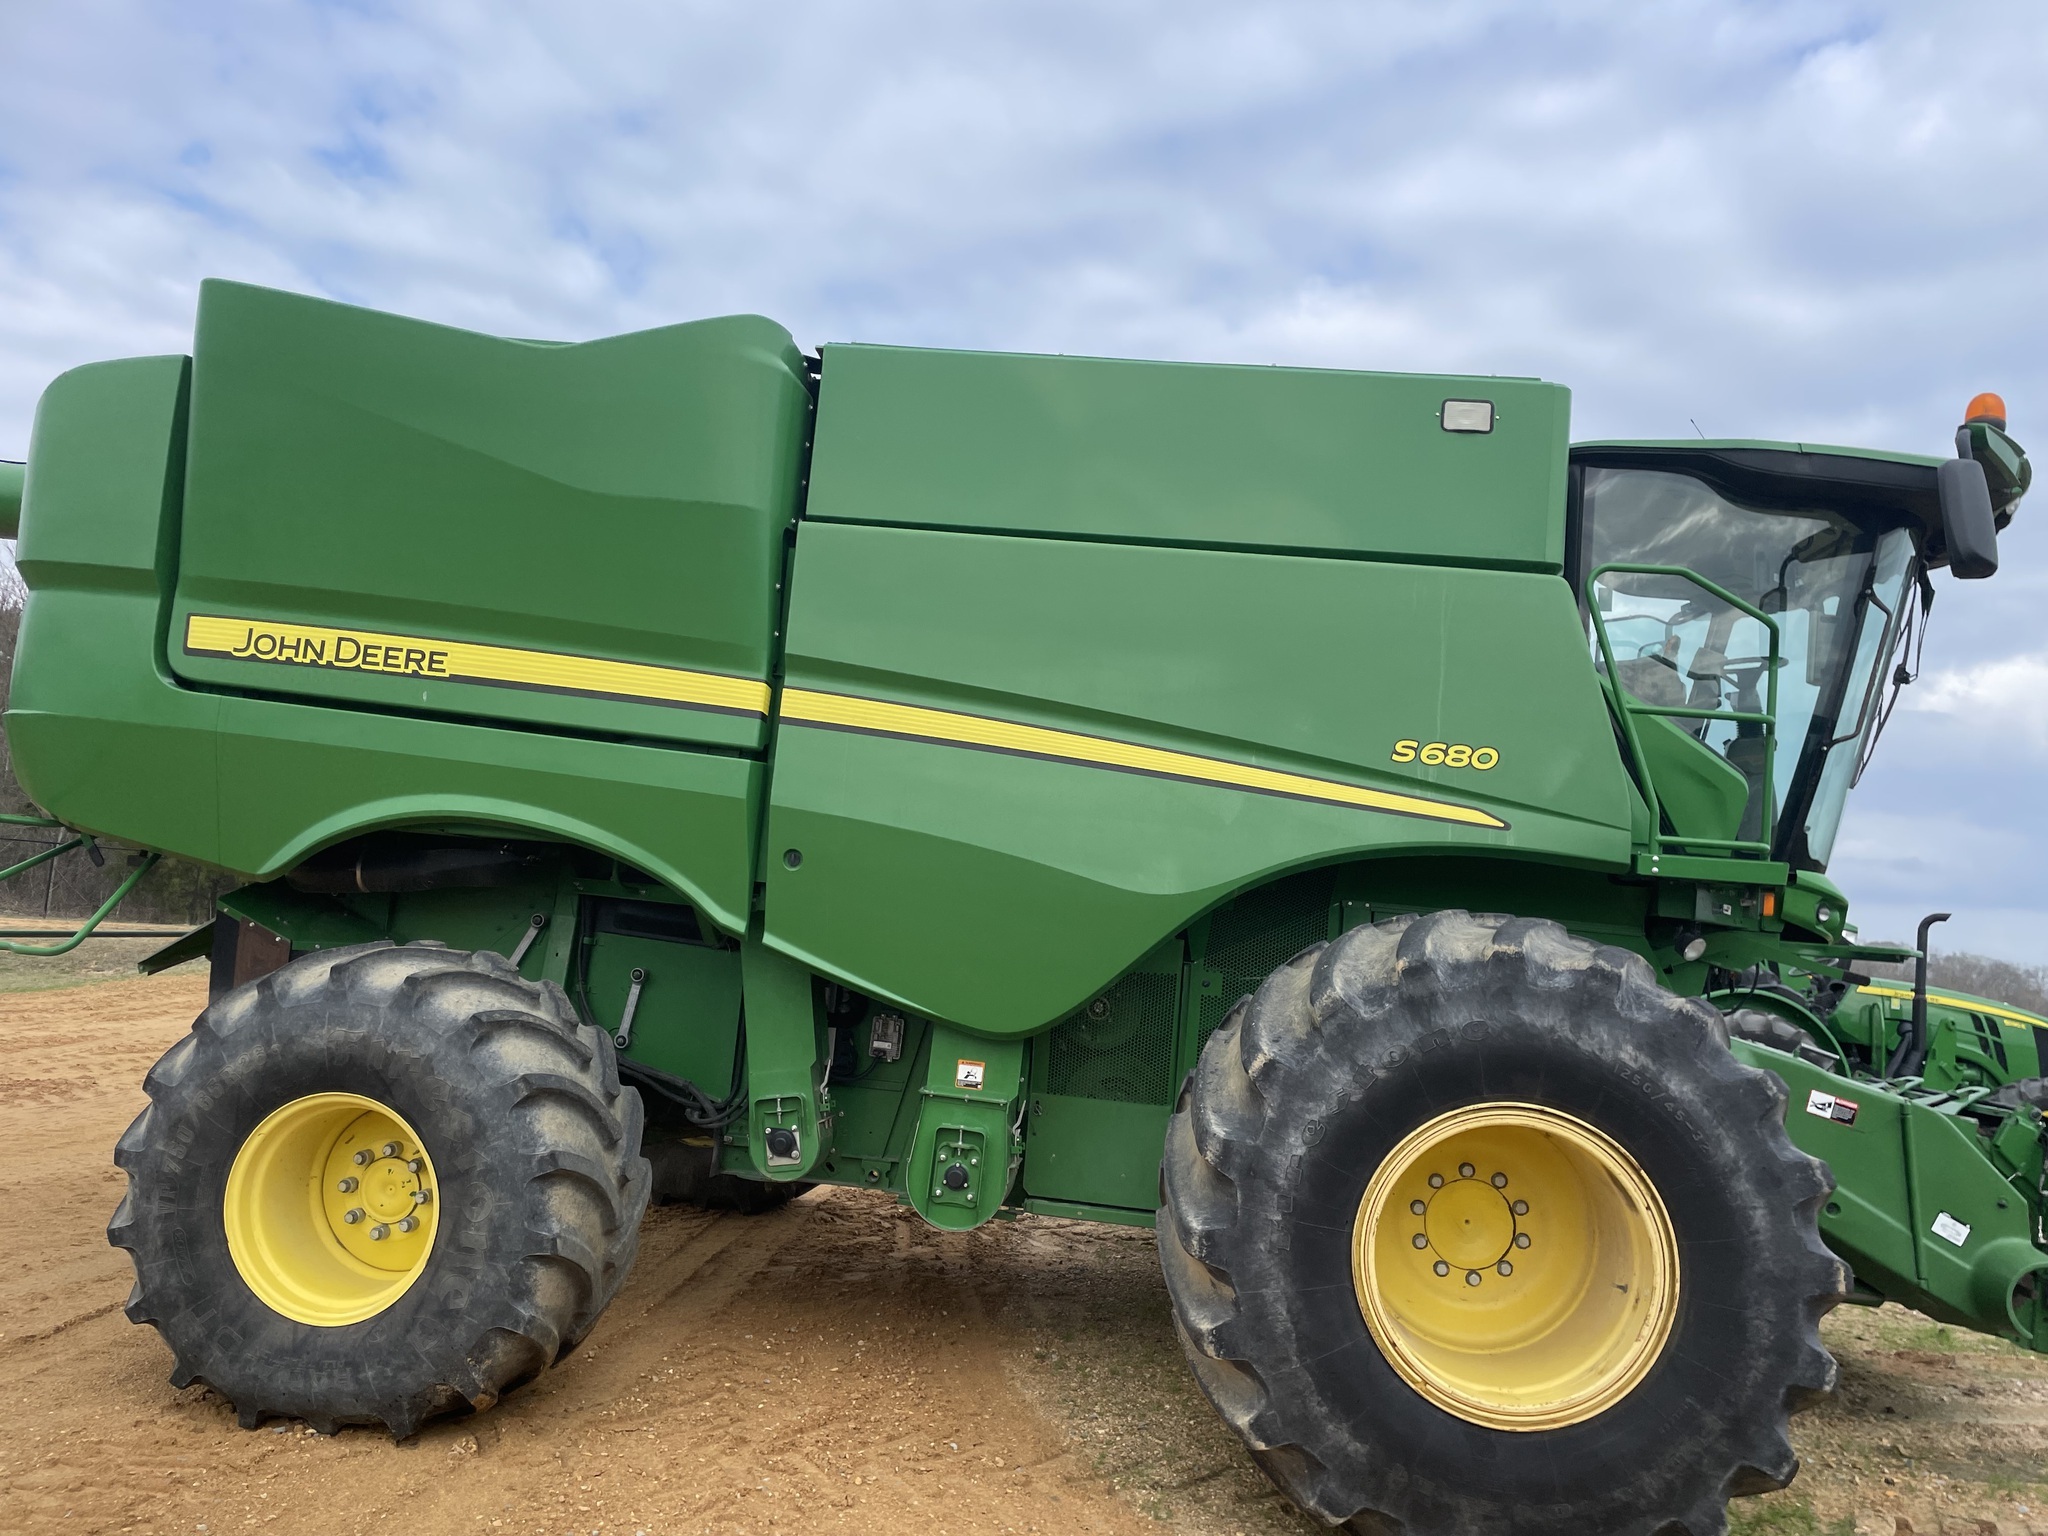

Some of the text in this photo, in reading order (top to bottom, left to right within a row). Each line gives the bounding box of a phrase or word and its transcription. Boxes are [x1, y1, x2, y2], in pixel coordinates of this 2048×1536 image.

[233, 628, 449, 673] JOHN DEERE
[1391, 739, 1500, 771] S680
[1613, 1063, 1710, 1153] 1250/45-32
